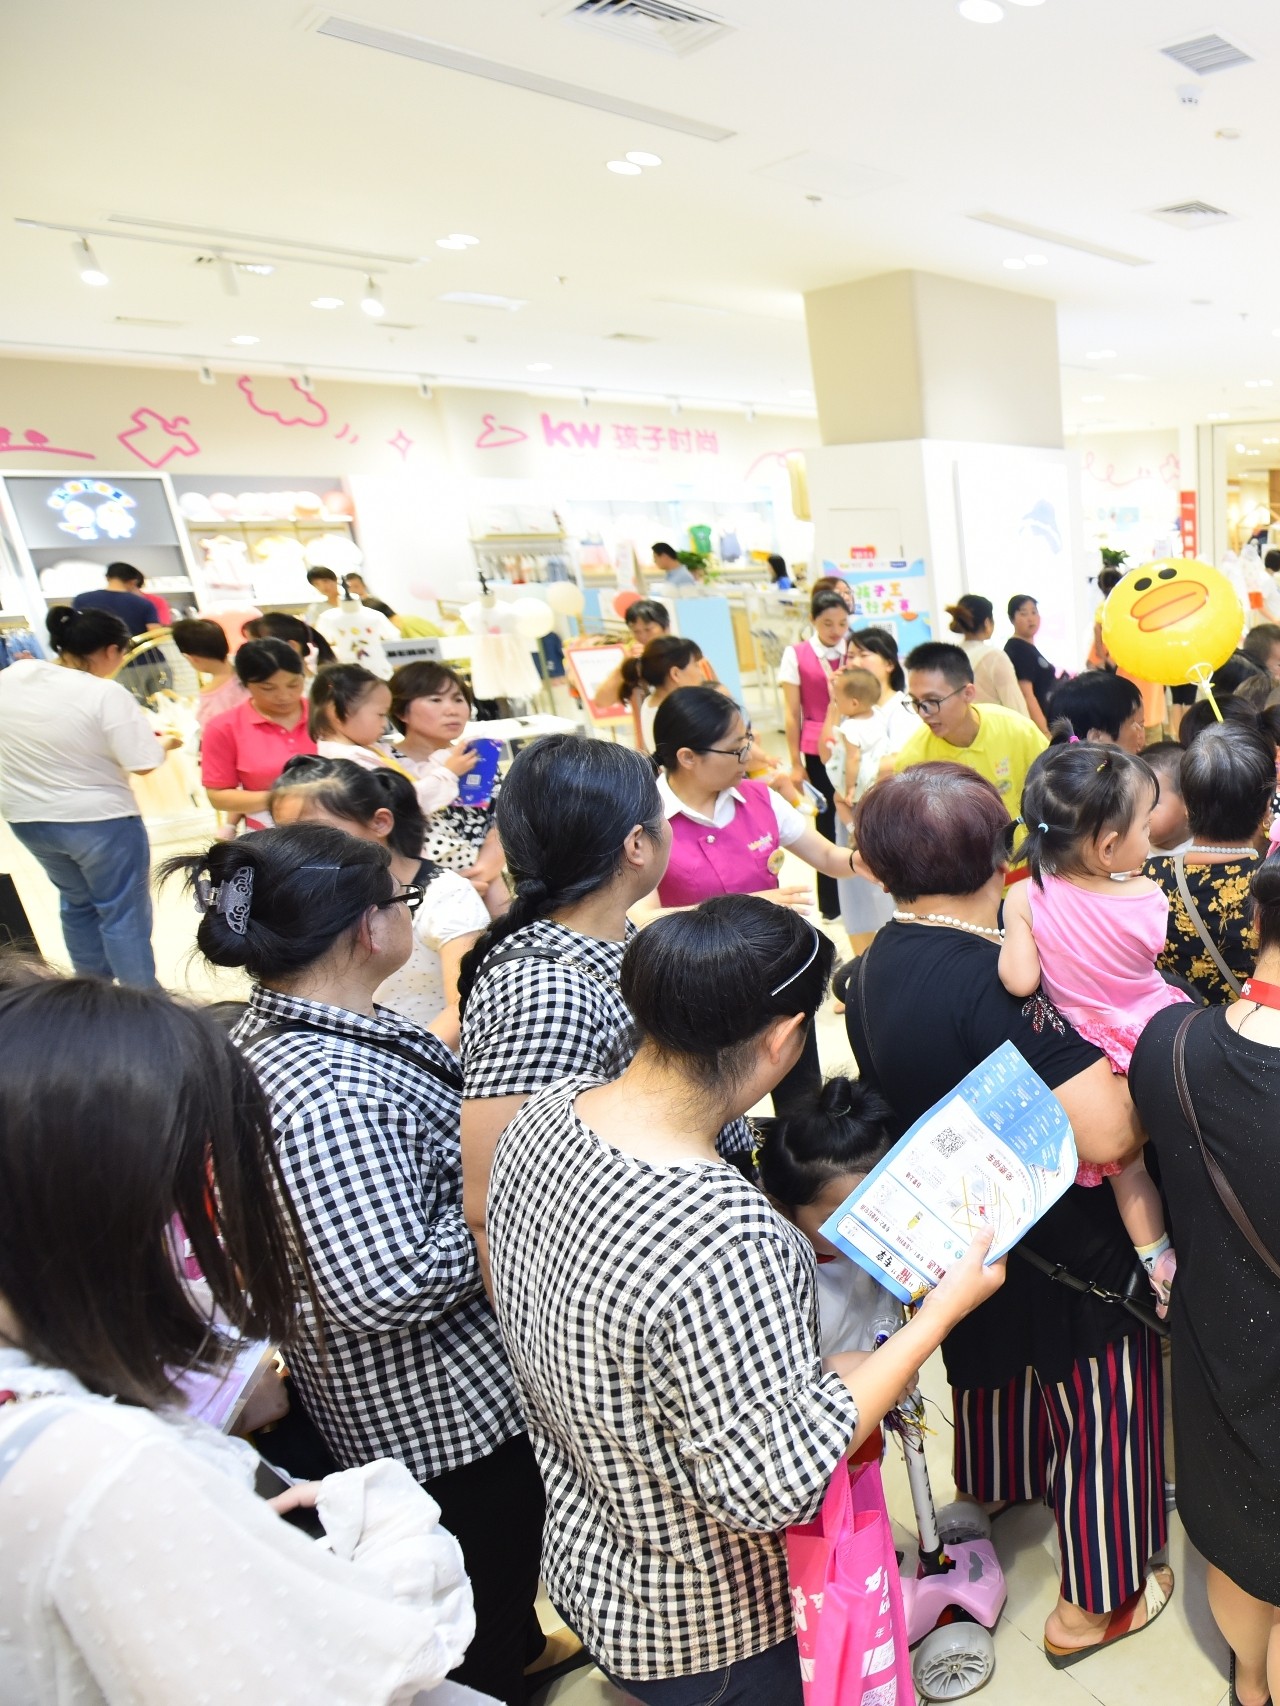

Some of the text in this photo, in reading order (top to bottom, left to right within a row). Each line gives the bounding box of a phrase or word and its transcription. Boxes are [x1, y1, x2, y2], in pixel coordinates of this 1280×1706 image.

[540, 412, 601, 448] kw
[611, 423, 720, 454] 孩子时尚
[983, 1152, 1016, 1182] 免费停车
